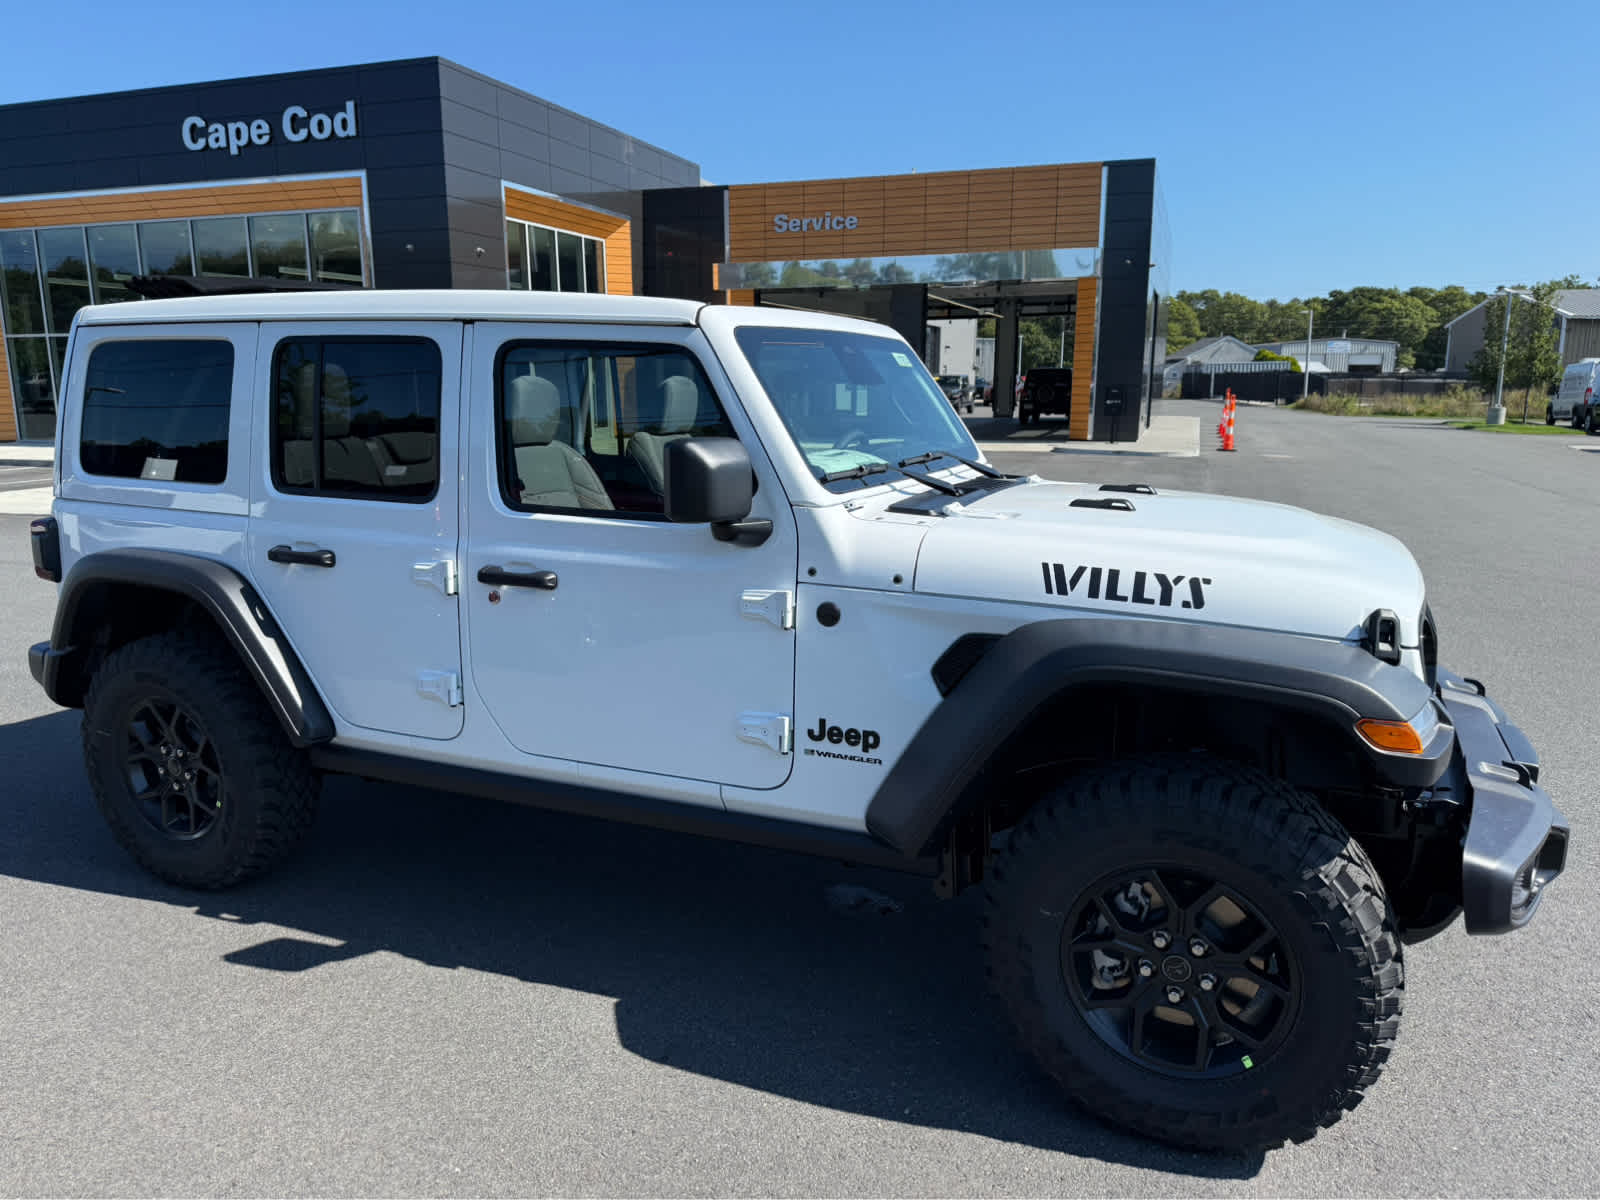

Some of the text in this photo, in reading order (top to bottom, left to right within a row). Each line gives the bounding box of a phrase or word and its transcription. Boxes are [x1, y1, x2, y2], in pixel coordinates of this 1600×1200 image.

[182, 100, 357, 155] Cape Cod
[774, 211, 858, 233] Service
[1041, 562, 1212, 610] WILLYS
[807, 718, 881, 753] Jeep
[815, 750, 882, 765] WRANGLER
